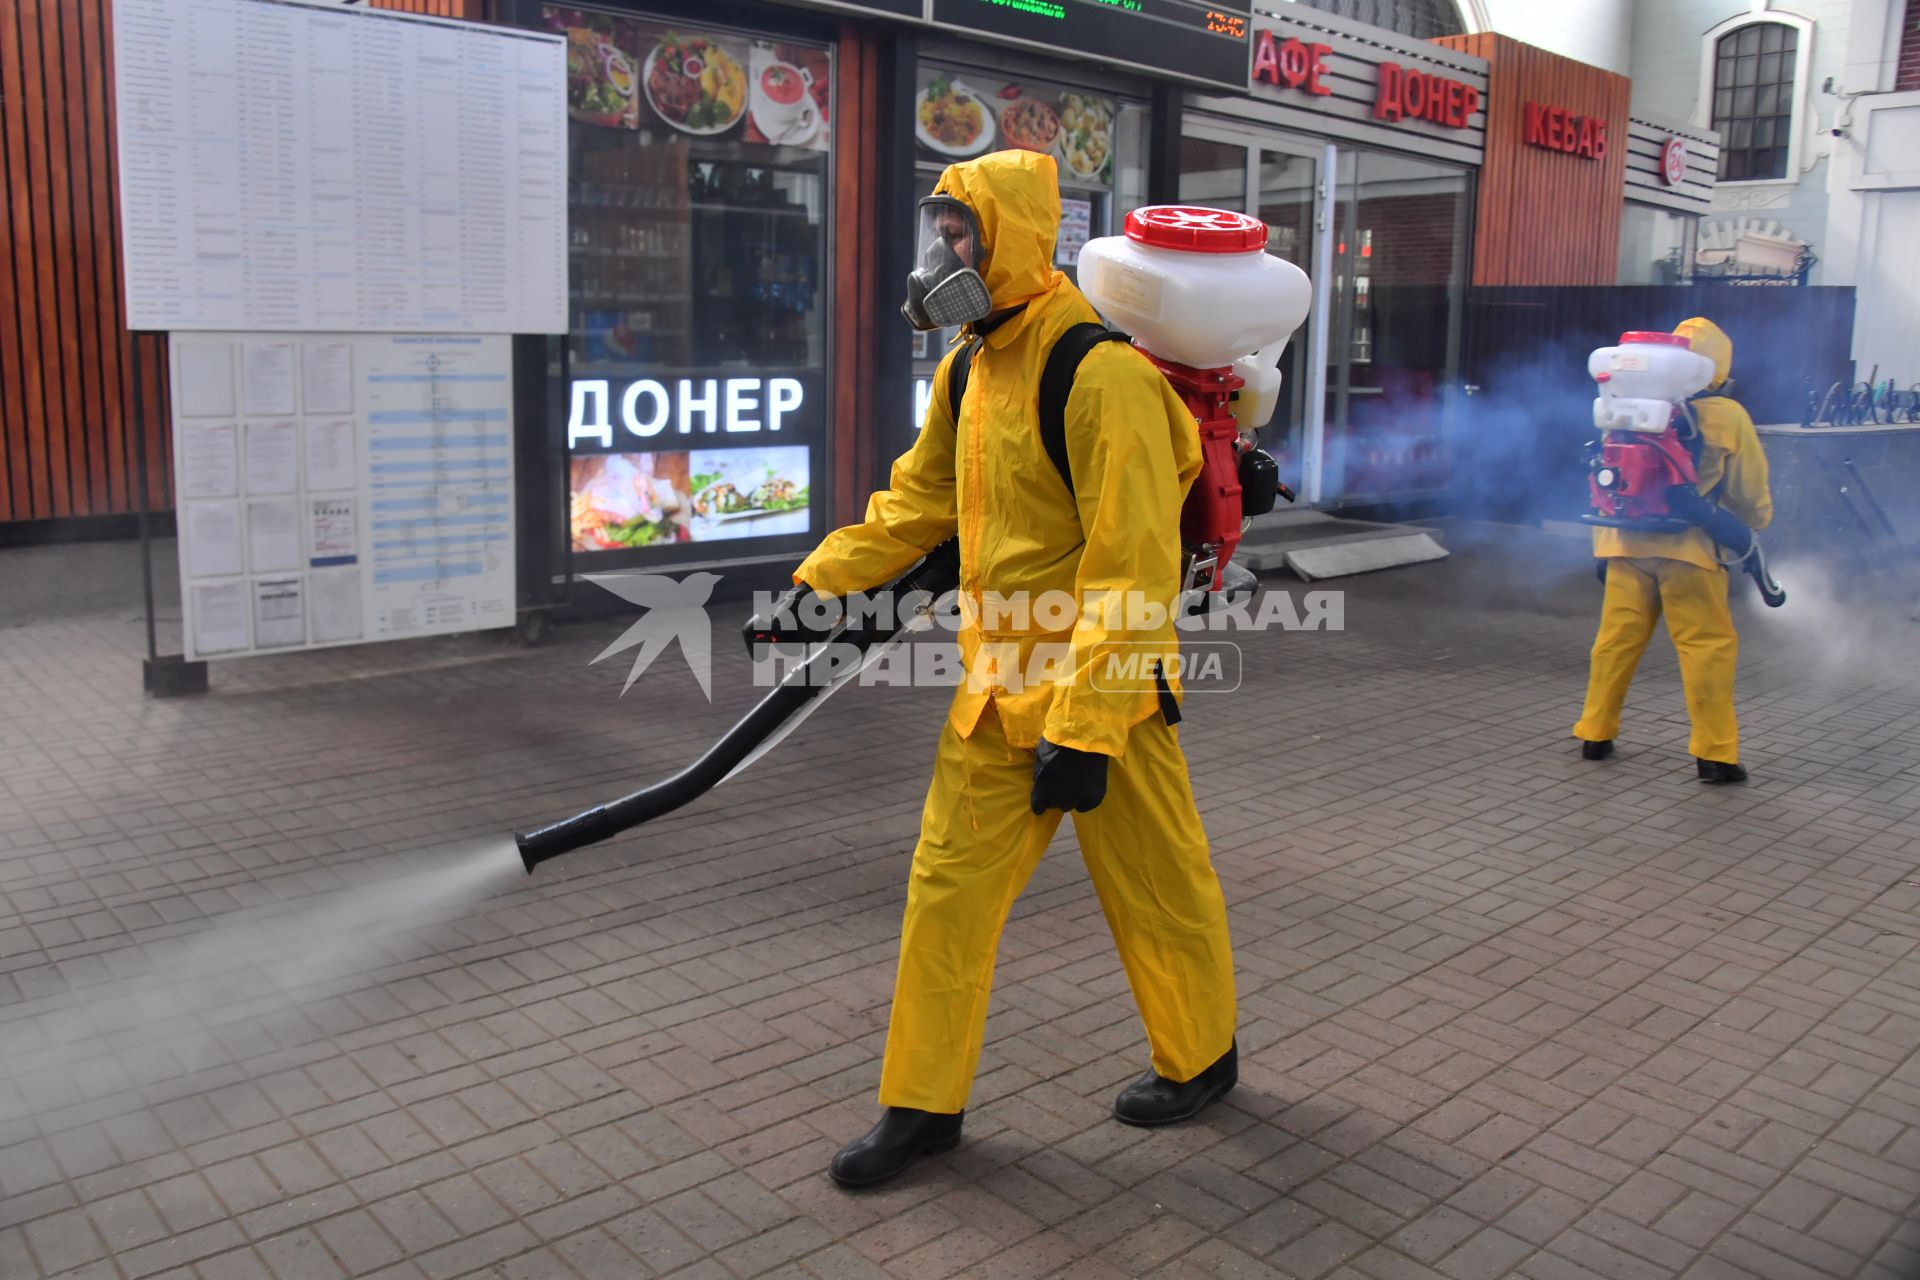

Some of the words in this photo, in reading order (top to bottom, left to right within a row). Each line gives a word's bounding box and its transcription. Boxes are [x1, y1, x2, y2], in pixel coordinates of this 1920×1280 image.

[1373, 61, 1479, 130] ДОНЕР
[1524, 101, 1608, 160] КЕБАБ
[567, 377, 804, 450] ДОНЕР
